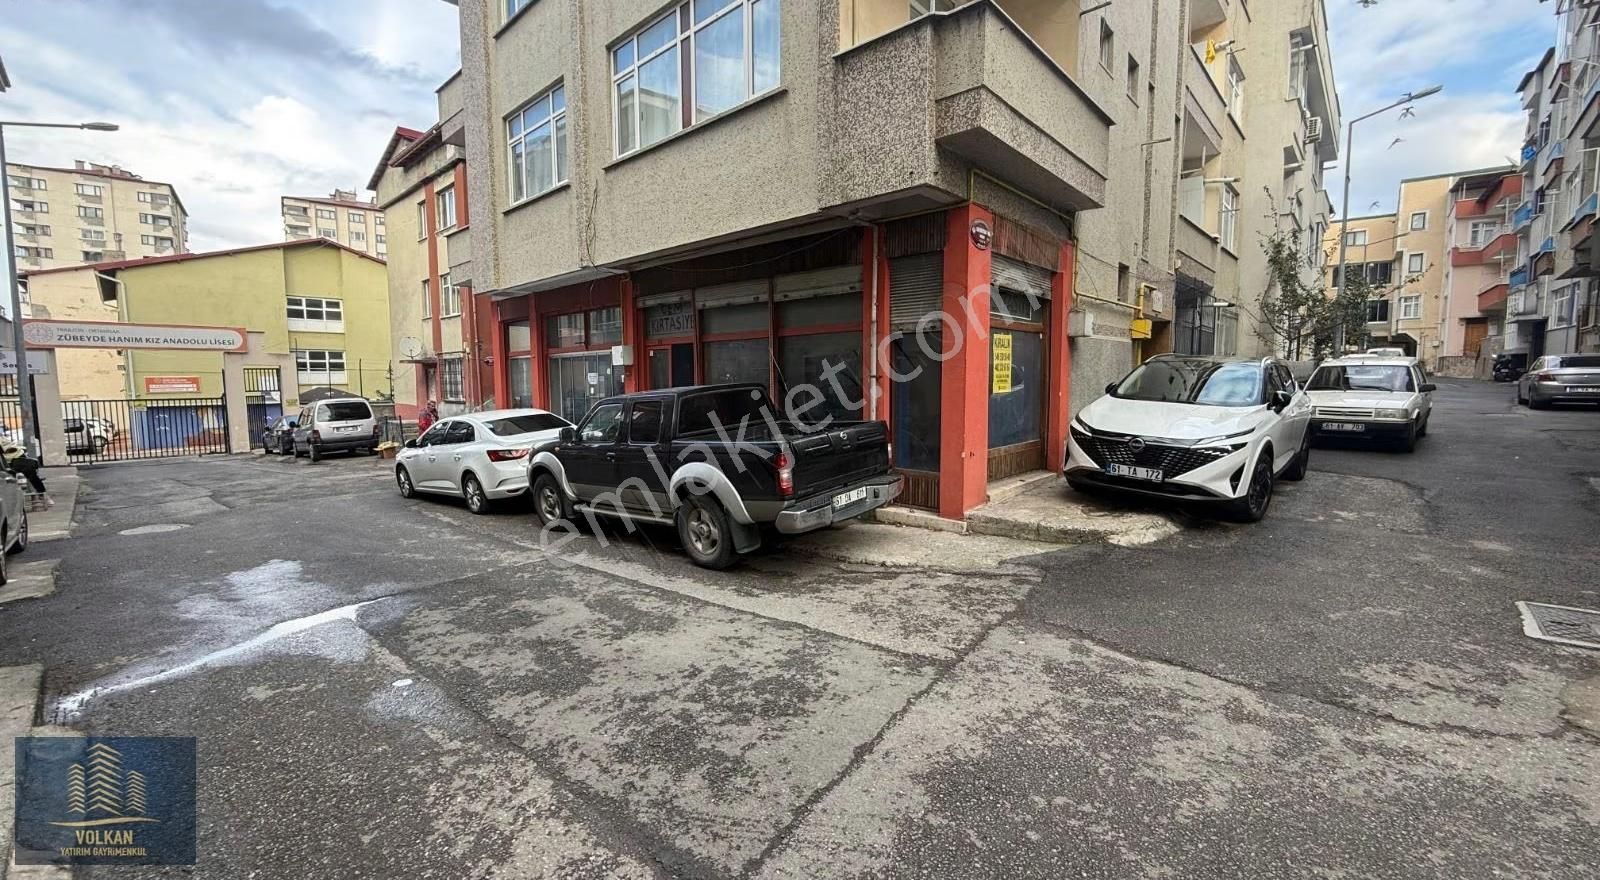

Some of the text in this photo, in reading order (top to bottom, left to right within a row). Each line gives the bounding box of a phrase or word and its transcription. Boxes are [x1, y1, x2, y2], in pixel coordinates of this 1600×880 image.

[57, 334, 106, 342] ZÜBEYDE
[162, 337, 207, 345] ANADOLU
[1111, 464, 1161, 480] 61 TA 172
